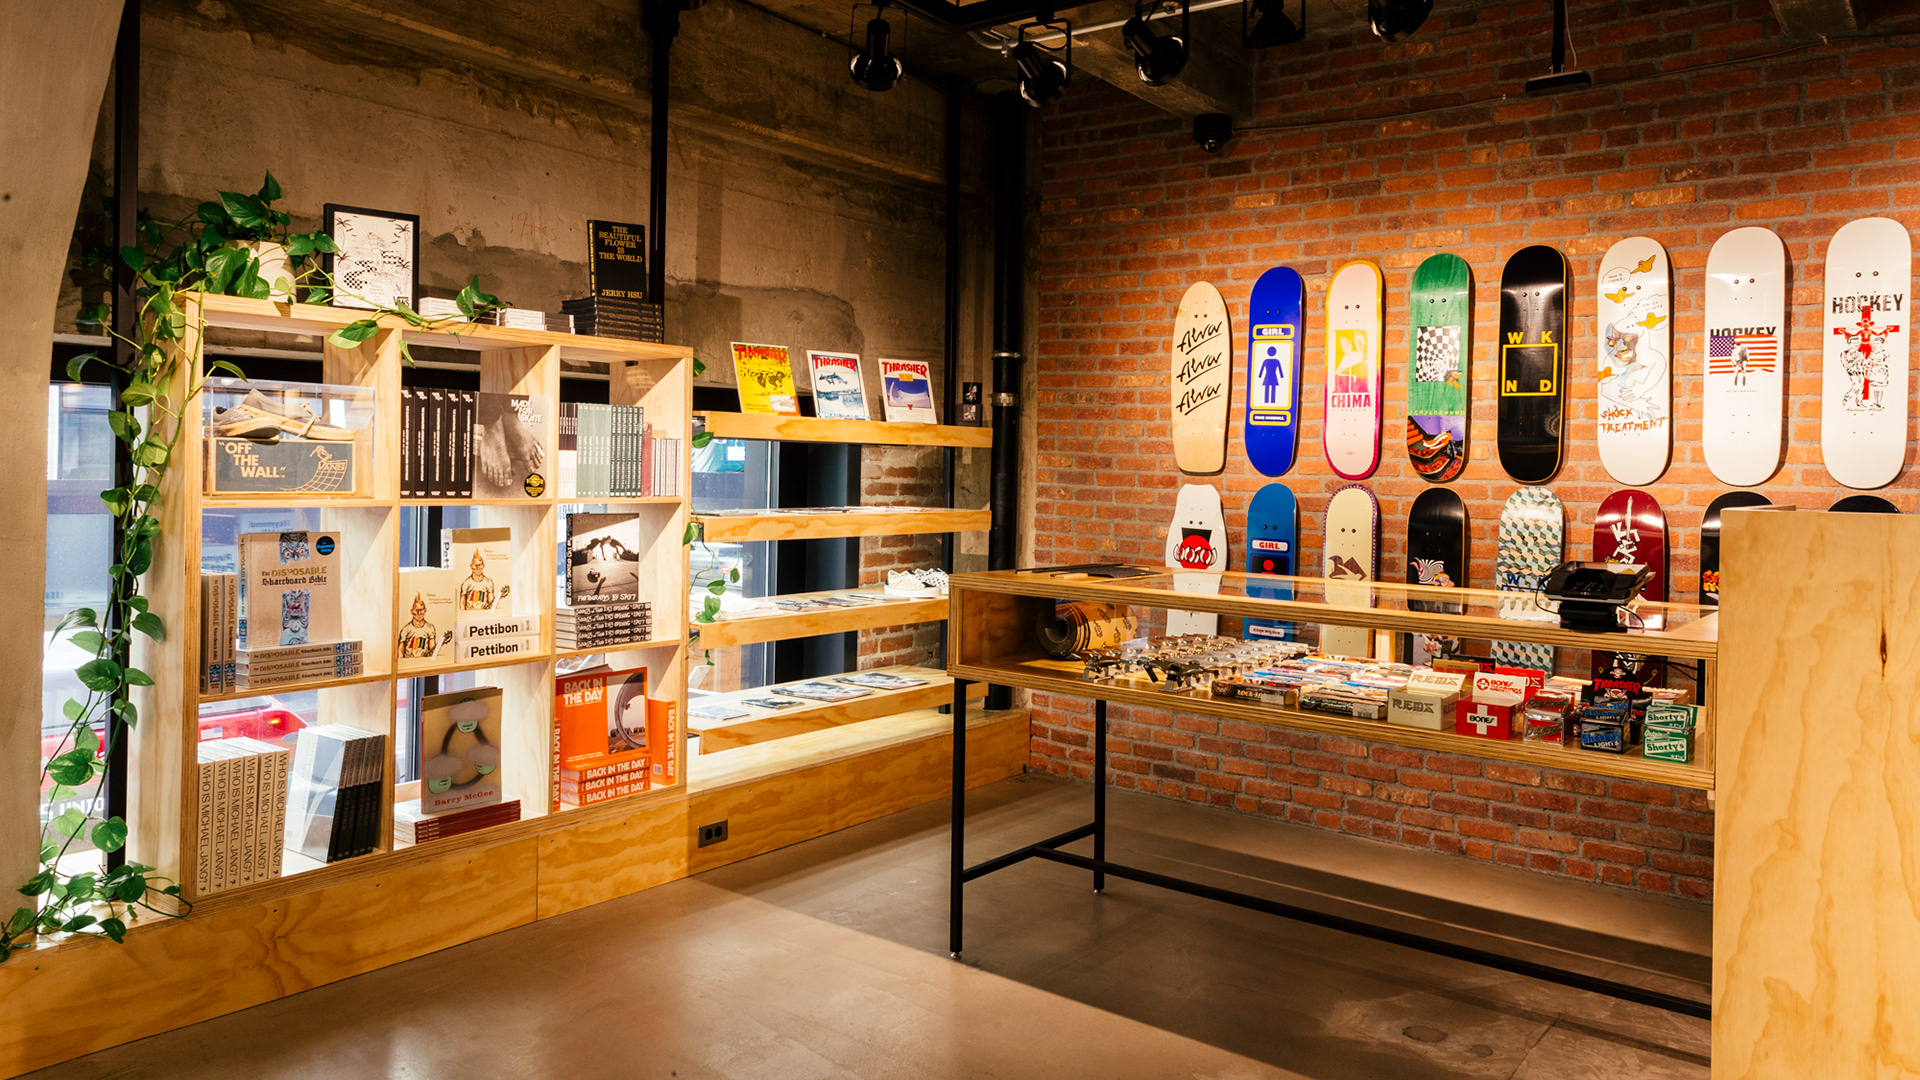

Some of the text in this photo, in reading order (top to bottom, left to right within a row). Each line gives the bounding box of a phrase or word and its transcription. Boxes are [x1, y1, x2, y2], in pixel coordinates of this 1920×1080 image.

[598, 231, 642, 242] BEAUTIFUL
[612, 226, 628, 234] THE
[604, 239, 637, 248] FLOWER
[598, 252, 643, 262] THE WORLD
[602, 289, 643, 299] JERRY HSU
[1832, 293, 1904, 314] HOCKEY
[1177, 321, 1222, 352] Alva
[1262, 328, 1284, 336] GIRL
[1508, 330, 1552, 344] W K
[734, 346, 786, 364] THRASHER
[812, 356, 856, 372] THRASHER
[882, 362, 928, 378] THRASHER
[1176, 352, 1222, 382] Alva
[1506, 380, 1552, 392] N D
[512, 399, 532, 411] MADE
[1176, 383, 1222, 412] Alva
[1331, 394, 1372, 408] CHIMA
[1600, 406, 1632, 420] SHOCK
[1599, 416, 1668, 434] TREATMENT
[233, 454, 260, 466] THE
[318, 463, 346, 472] VANS
[1258, 542, 1280, 550] GIRL
[272, 566, 328, 576] DISPOSABLE
[470, 622, 518, 638] Pettibon
[470, 642, 518, 658] Pettibon
[564, 678, 602, 694] BACK IN
[1594, 678, 1641, 696] THRASHER
[564, 692, 582, 705] THE
[584, 689, 604, 702] DAY
[1469, 714, 1495, 724] BONES
[668, 733, 675, 744] IN
[1582, 730, 1622, 742] Shorty's
[1646, 741, 1684, 752] Shorty's
[553, 754, 560, 766] IN
[587, 758, 646, 778] BACK IN THE DAY
[586, 770, 644, 790] BACK IN THE DAY
[434, 790, 494, 806] Barry McGee
[586, 782, 644, 802] BACK IN THE DAY
[244, 758, 256, 873] WHO IS MICHAEL JANG?
[258, 754, 272, 870] WHO IS MICHAEL JANG?
[272, 752, 288, 866] WHO IS MICHAEL JANG?
[199, 765, 212, 883] WHO IS MICHAEL JANG?
[214, 762, 227, 880] WHO IS MICHAEL JANG?
[230, 760, 241, 876] WHO IS MICHAEL JANG?
